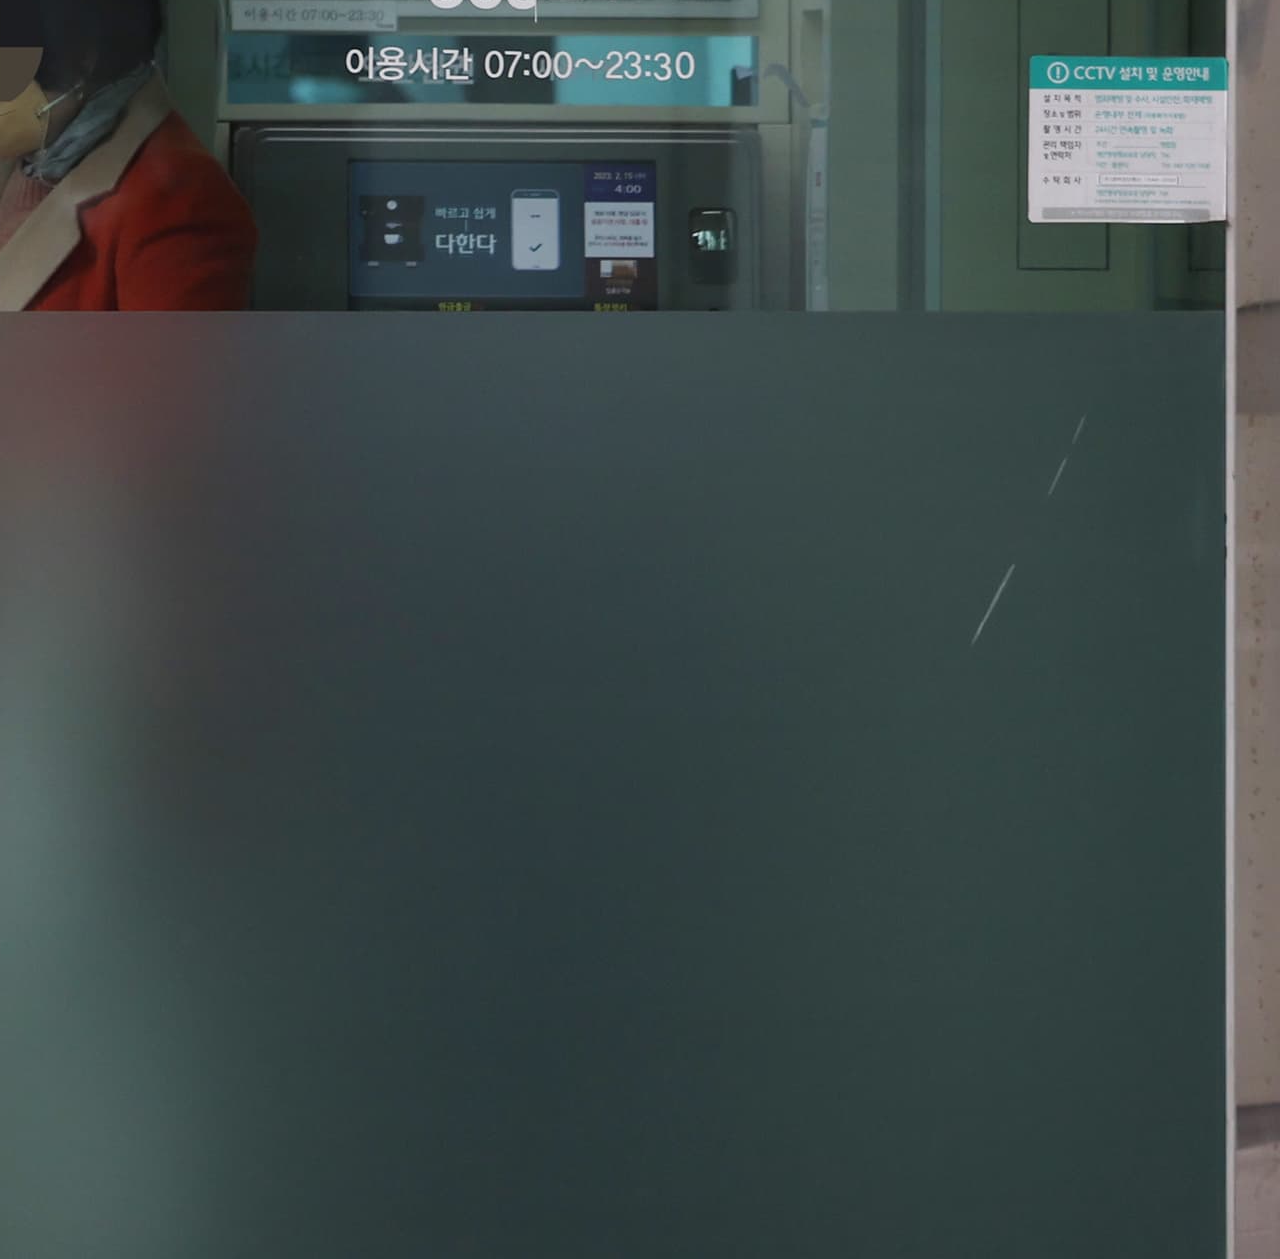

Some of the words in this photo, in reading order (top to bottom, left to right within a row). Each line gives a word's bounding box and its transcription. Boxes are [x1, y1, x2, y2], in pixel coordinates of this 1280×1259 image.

[345, 47, 473, 81] 이용시간
[484, 49, 696, 82] 07:00~23:30
[1073, 65, 1116, 80] CCTV
[1119, 66, 1142, 81] 설치
[1146, 66, 1159, 81] 및
[1162, 66, 1210, 82] 운영안내
[435, 233, 499, 255] 다한다
